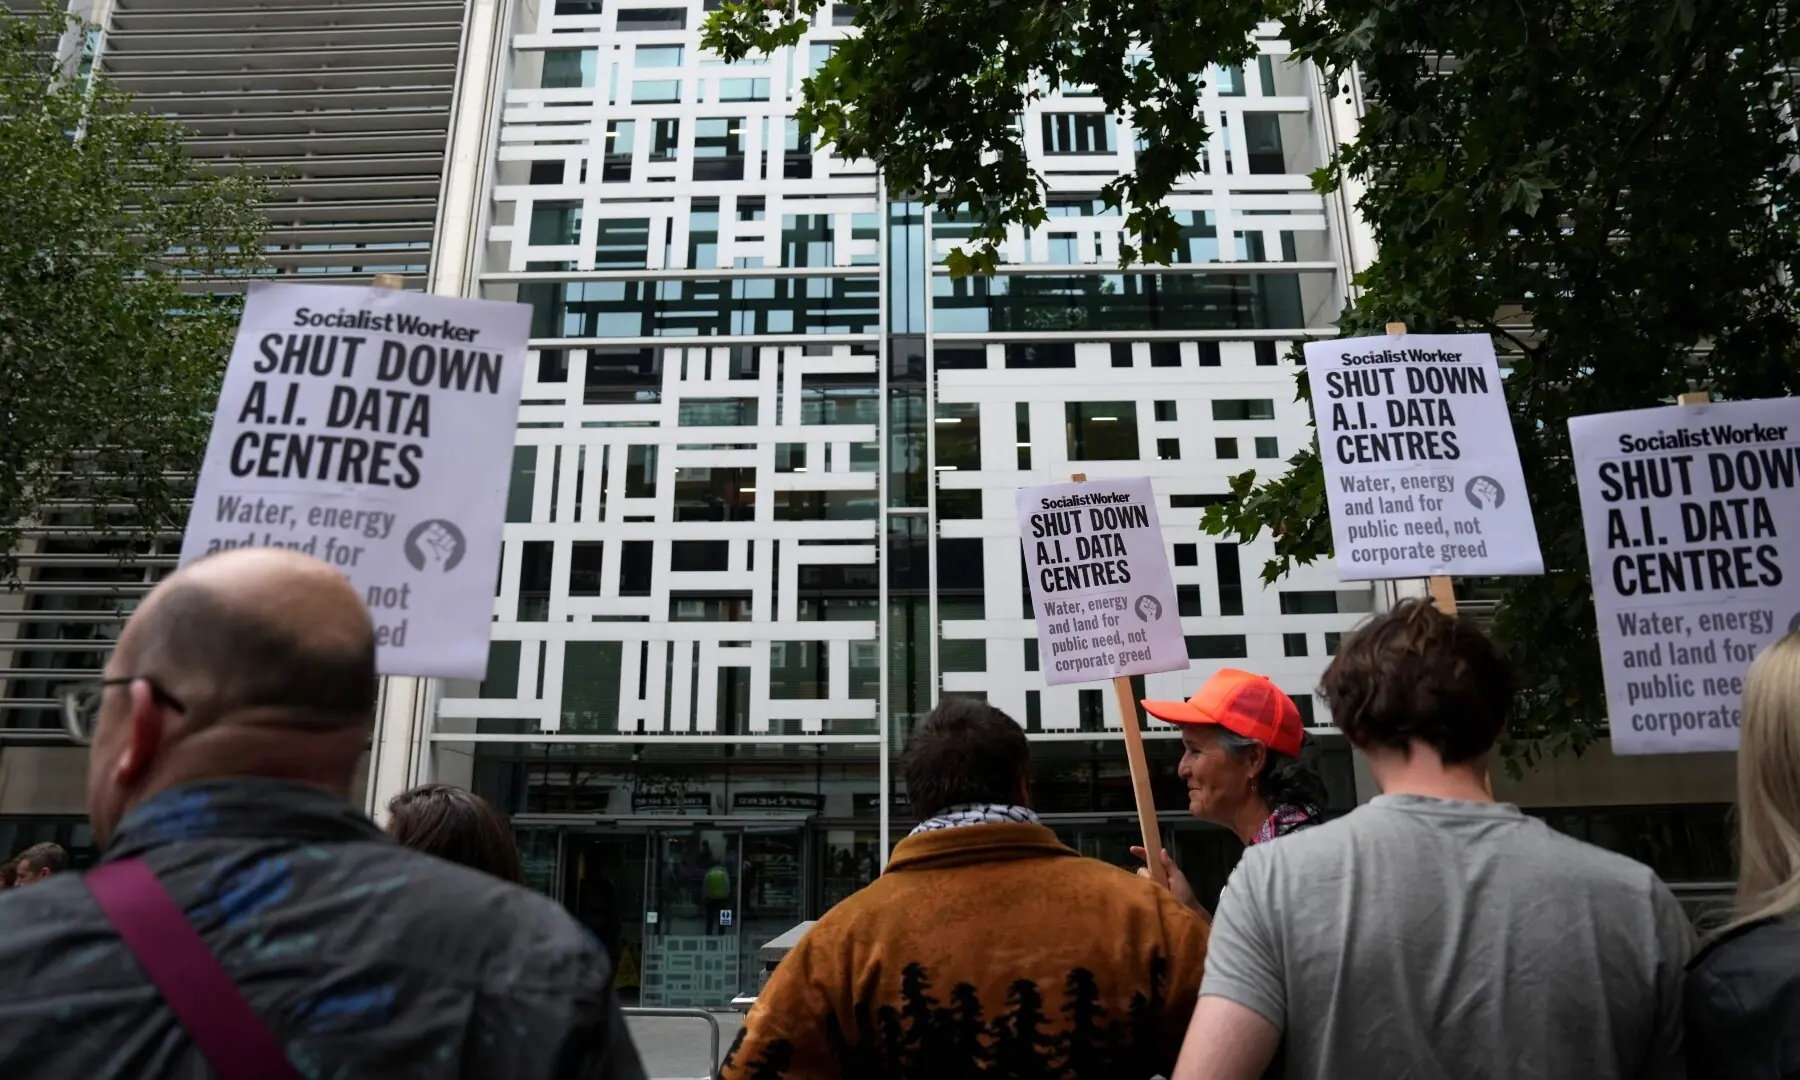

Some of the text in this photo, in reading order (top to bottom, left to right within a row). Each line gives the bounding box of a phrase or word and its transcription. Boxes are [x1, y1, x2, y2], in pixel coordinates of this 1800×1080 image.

[253, 333, 504, 395] SHUT DOWN
[1326, 366, 1489, 399] SHUT DOWN
[238, 380, 431, 438] A.I. DATA
[1332, 398, 1456, 431] A.I. DATA
[229, 431, 424, 489] CENTRES
[1336, 430, 1460, 465] CENTRES
[1340, 474, 1455, 493] Water, energy
[1599, 456, 1693, 502] SHUT
[215, 495, 397, 539] Water, energy
[1030, 504, 1149, 538] SHUT DOWN
[1344, 494, 1443, 516] and land for
[1348, 516, 1482, 543] public need, not
[1607, 496, 1777, 550] A.I. DATA
[325, 537, 365, 567] for
[1036, 532, 1127, 566] A.I. DATA
[1351, 540, 1488, 565] corporate greed
[1040, 559, 1131, 593] CENTRES
[1612, 544, 1783, 597] CENTRES
[366, 581, 411, 610] not
[1044, 595, 1128, 617] Water, energy
[1048, 613, 1120, 635] and land for
[1617, 608, 1774, 639] Water, energy
[1052, 628, 1148, 657] public need, not
[1622, 637, 1757, 668] and land for
[1055, 646, 1152, 673] corporate greed
[1627, 672, 1743, 706] public nee
[1632, 704, 1741, 737] corporate
